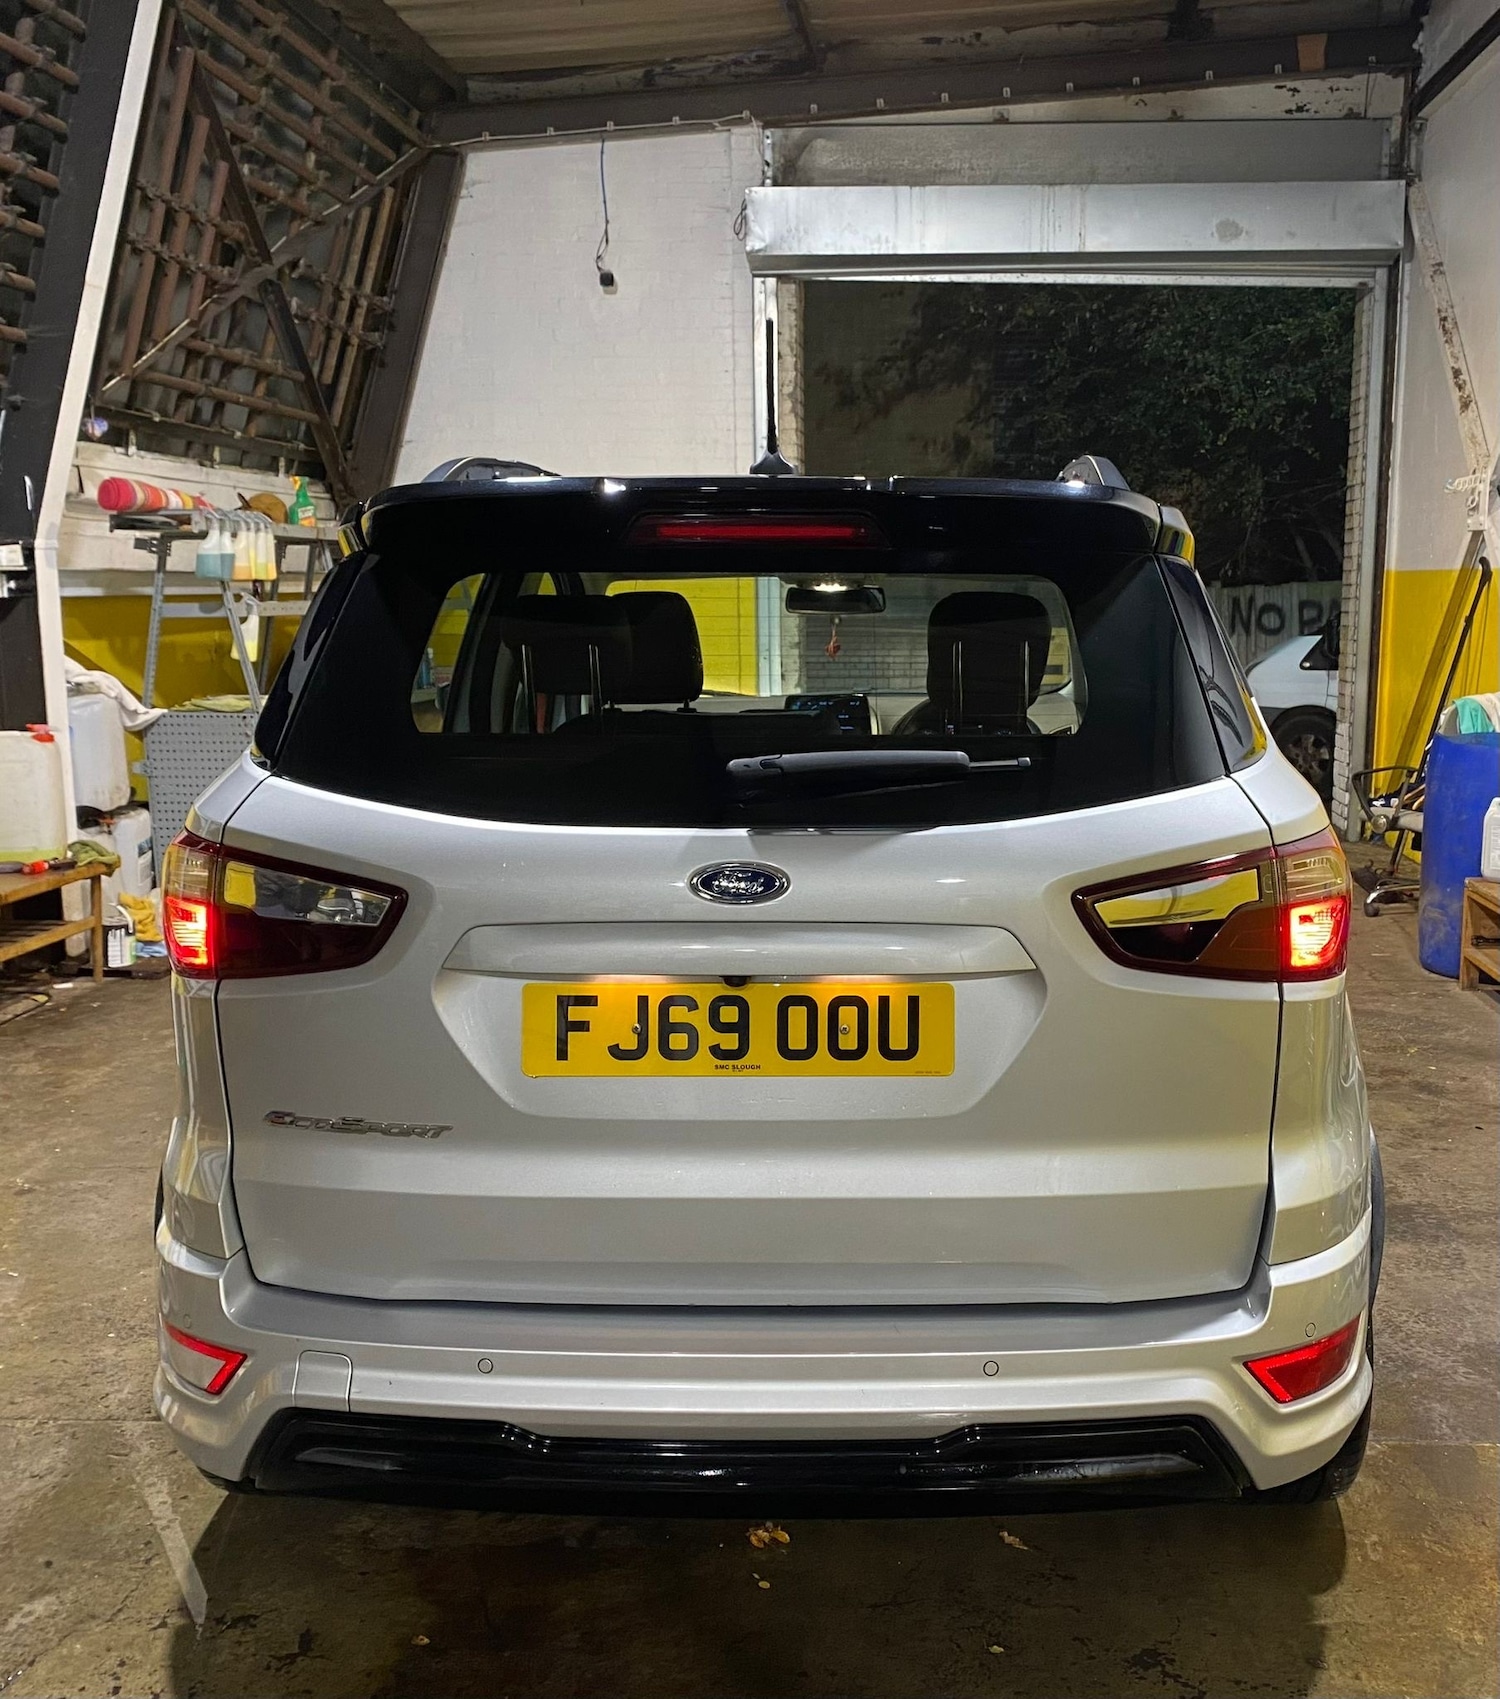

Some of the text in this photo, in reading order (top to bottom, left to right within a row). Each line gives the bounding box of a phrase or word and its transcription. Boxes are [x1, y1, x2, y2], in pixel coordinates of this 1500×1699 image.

[1230, 592, 1285, 638] NO
[711, 870, 765, 895] Ford
[556, 994, 920, 1061] FJ69 OOU
